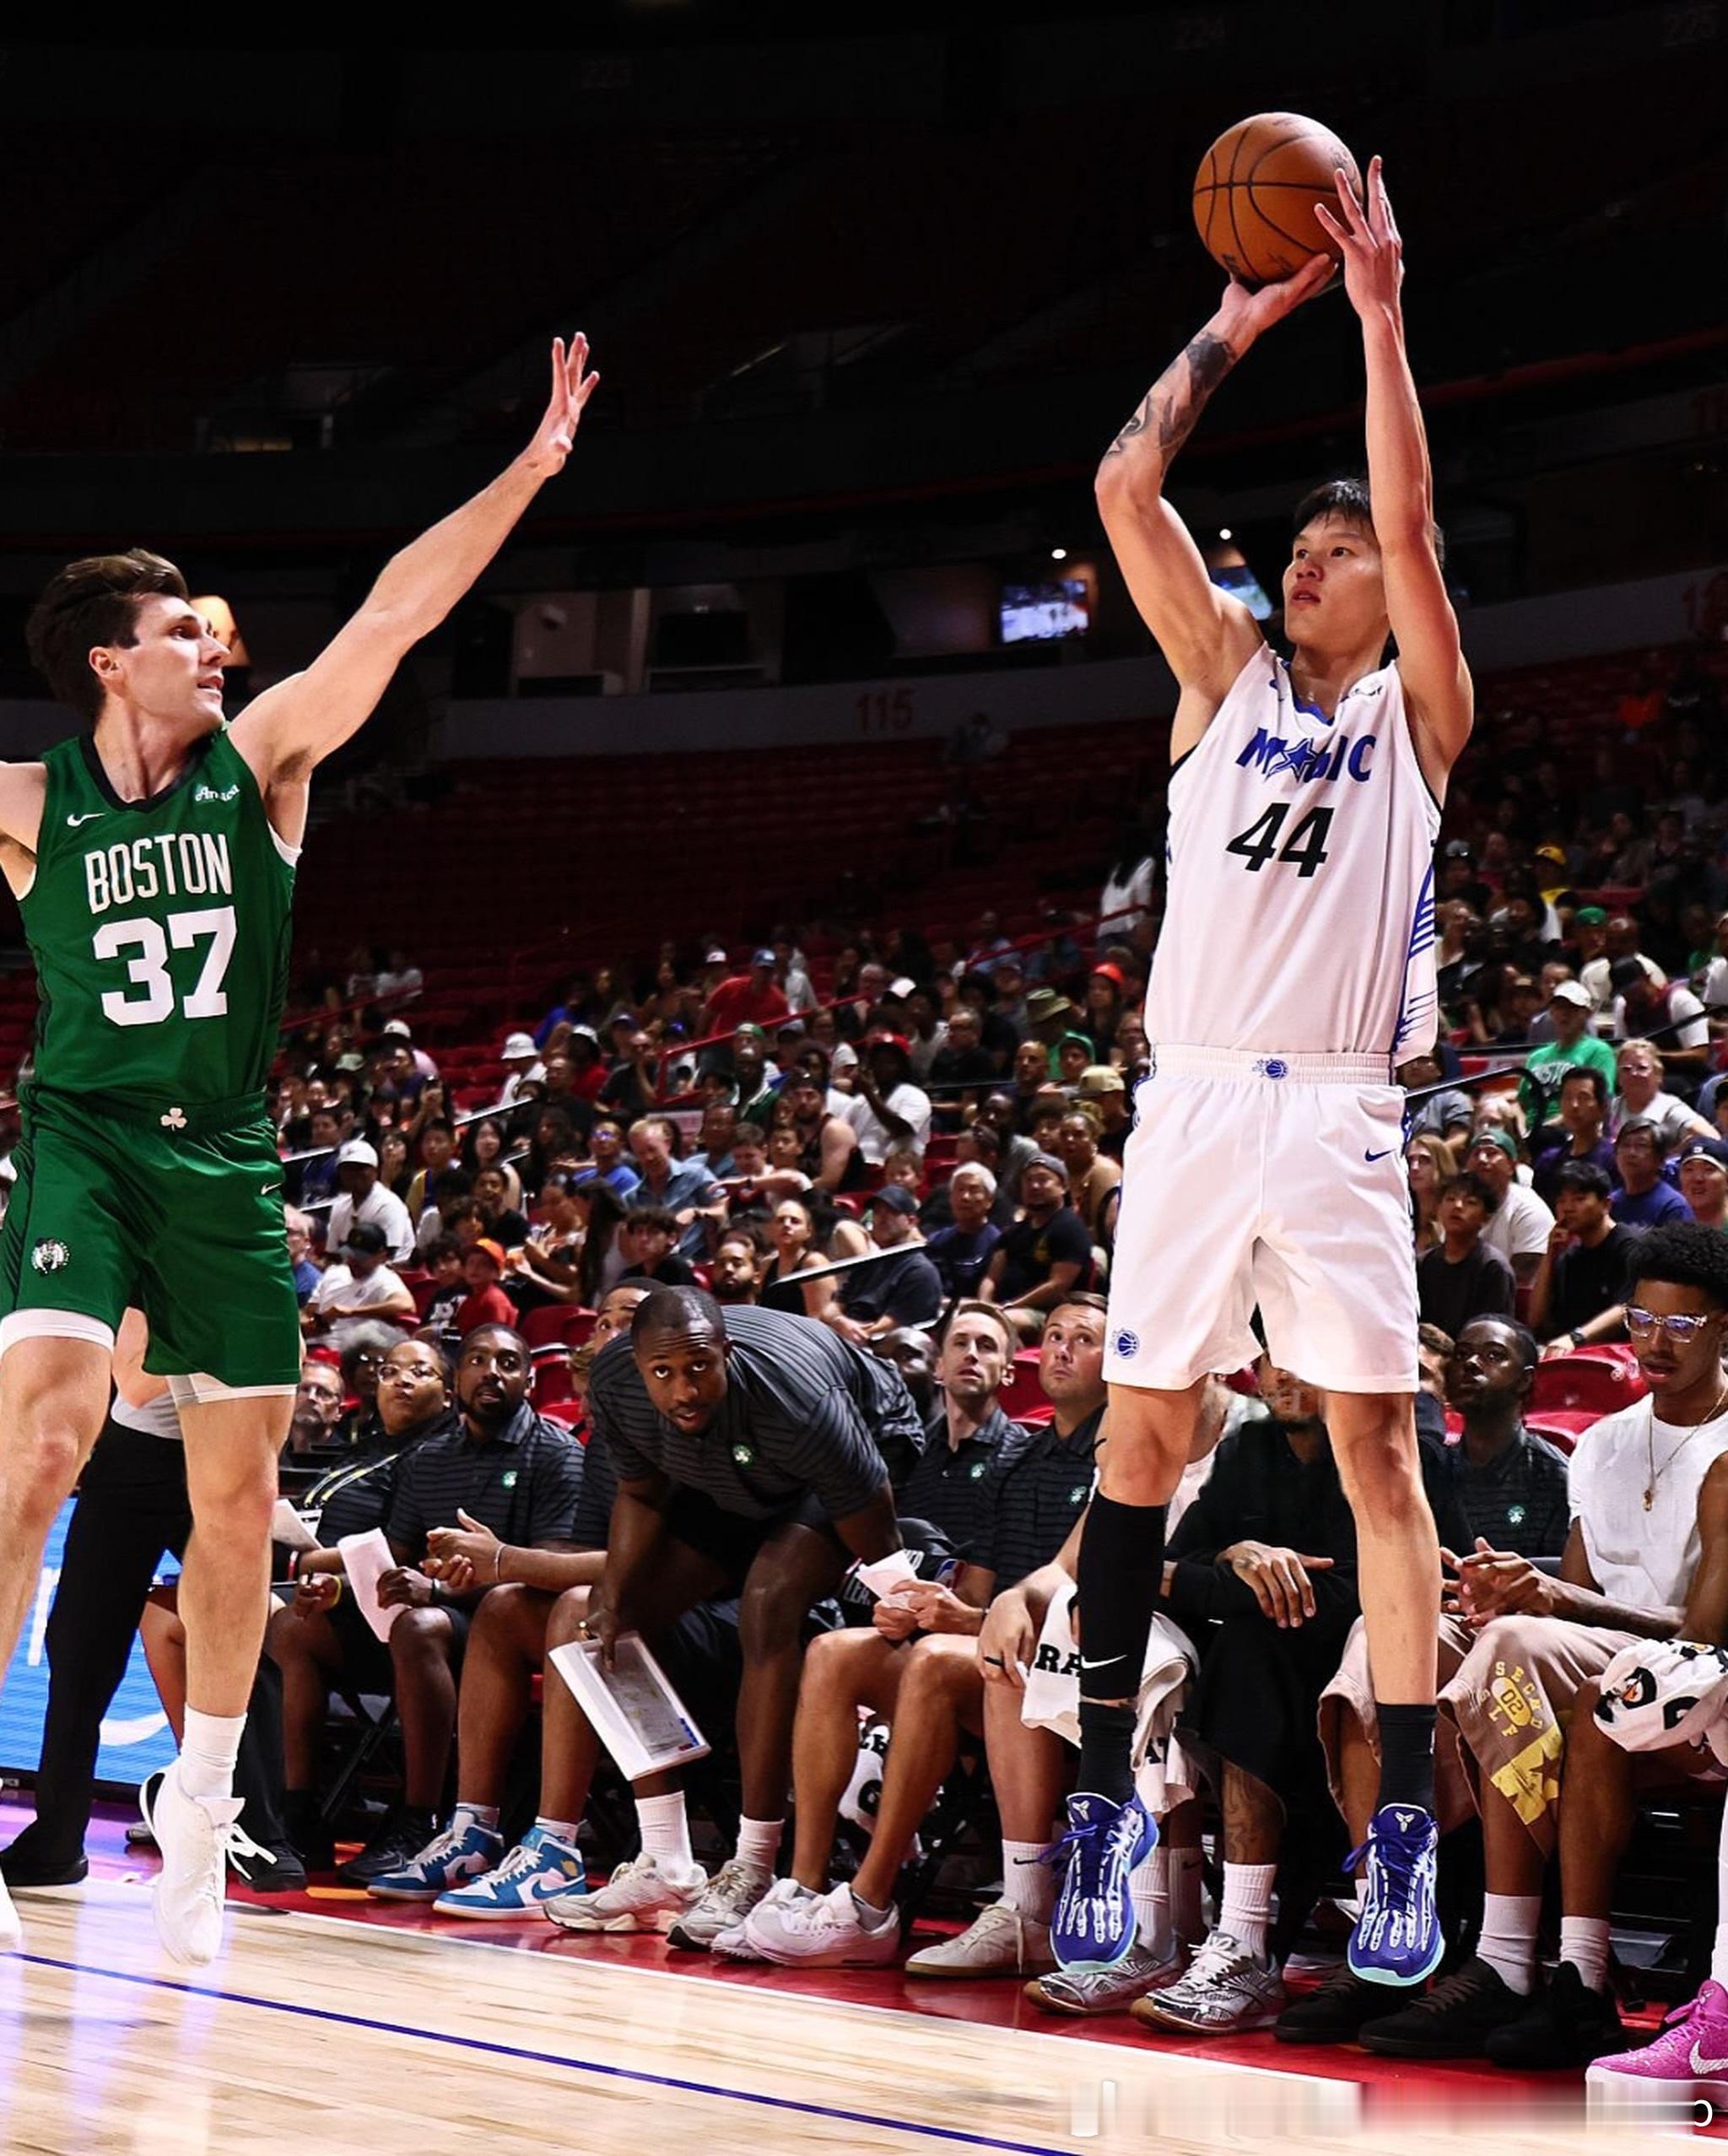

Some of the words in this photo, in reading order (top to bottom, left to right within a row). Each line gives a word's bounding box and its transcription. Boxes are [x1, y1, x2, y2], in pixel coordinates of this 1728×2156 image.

[856, 689, 913, 730] 115
[84, 833, 232, 914] BOSTON
[1225, 802, 1335, 878] 44
[93, 905, 237, 1026] 37
